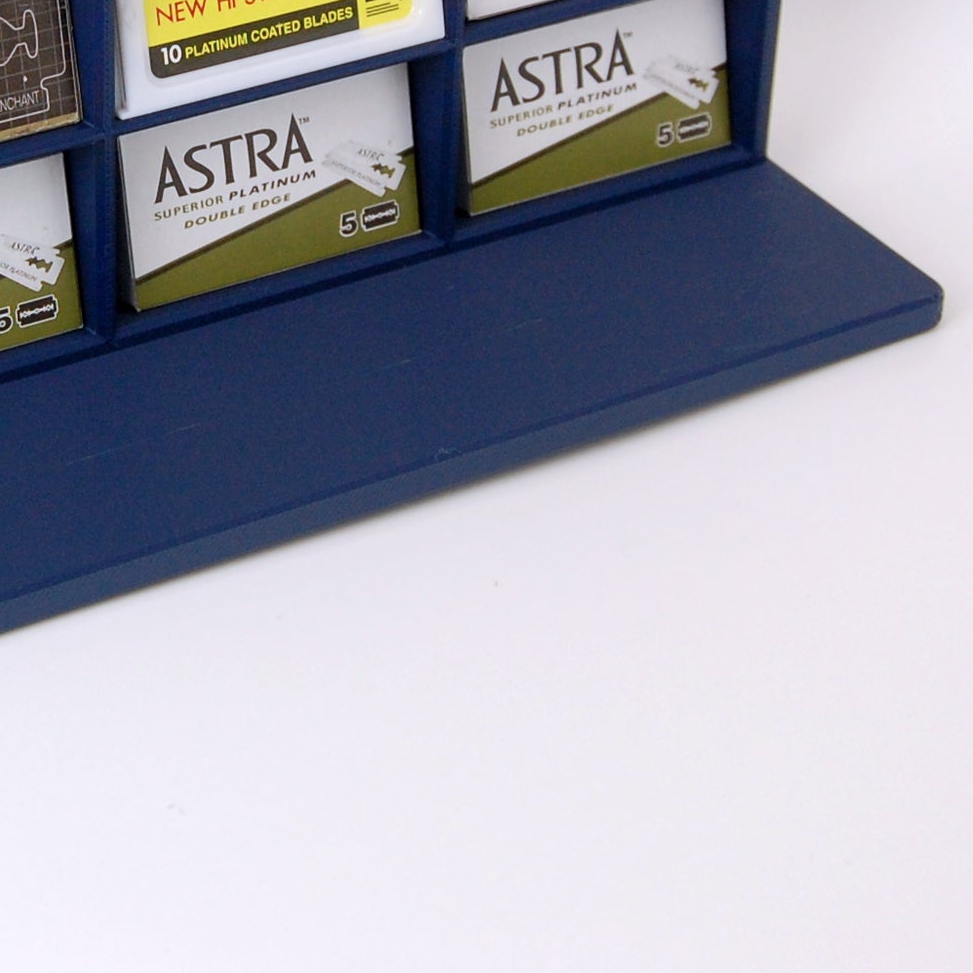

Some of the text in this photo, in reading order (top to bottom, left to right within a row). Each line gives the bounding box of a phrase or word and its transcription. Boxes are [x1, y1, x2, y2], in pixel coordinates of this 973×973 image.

[161, 7, 353, 65] 10 PLATINUM COATED BLADES
[490, 105, 553, 129] SUPERIOR
[558, 83, 637, 111] PLATINUM
[517, 105, 614, 137] DOUBLE EDGE
[657, 122, 674, 147] 5
[154, 195, 223, 221] SUPERIOR
[229, 169, 316, 201] PLATINUM
[184, 193, 291, 229] DOUBLE EDGE
[339, 212, 358, 237] 5
